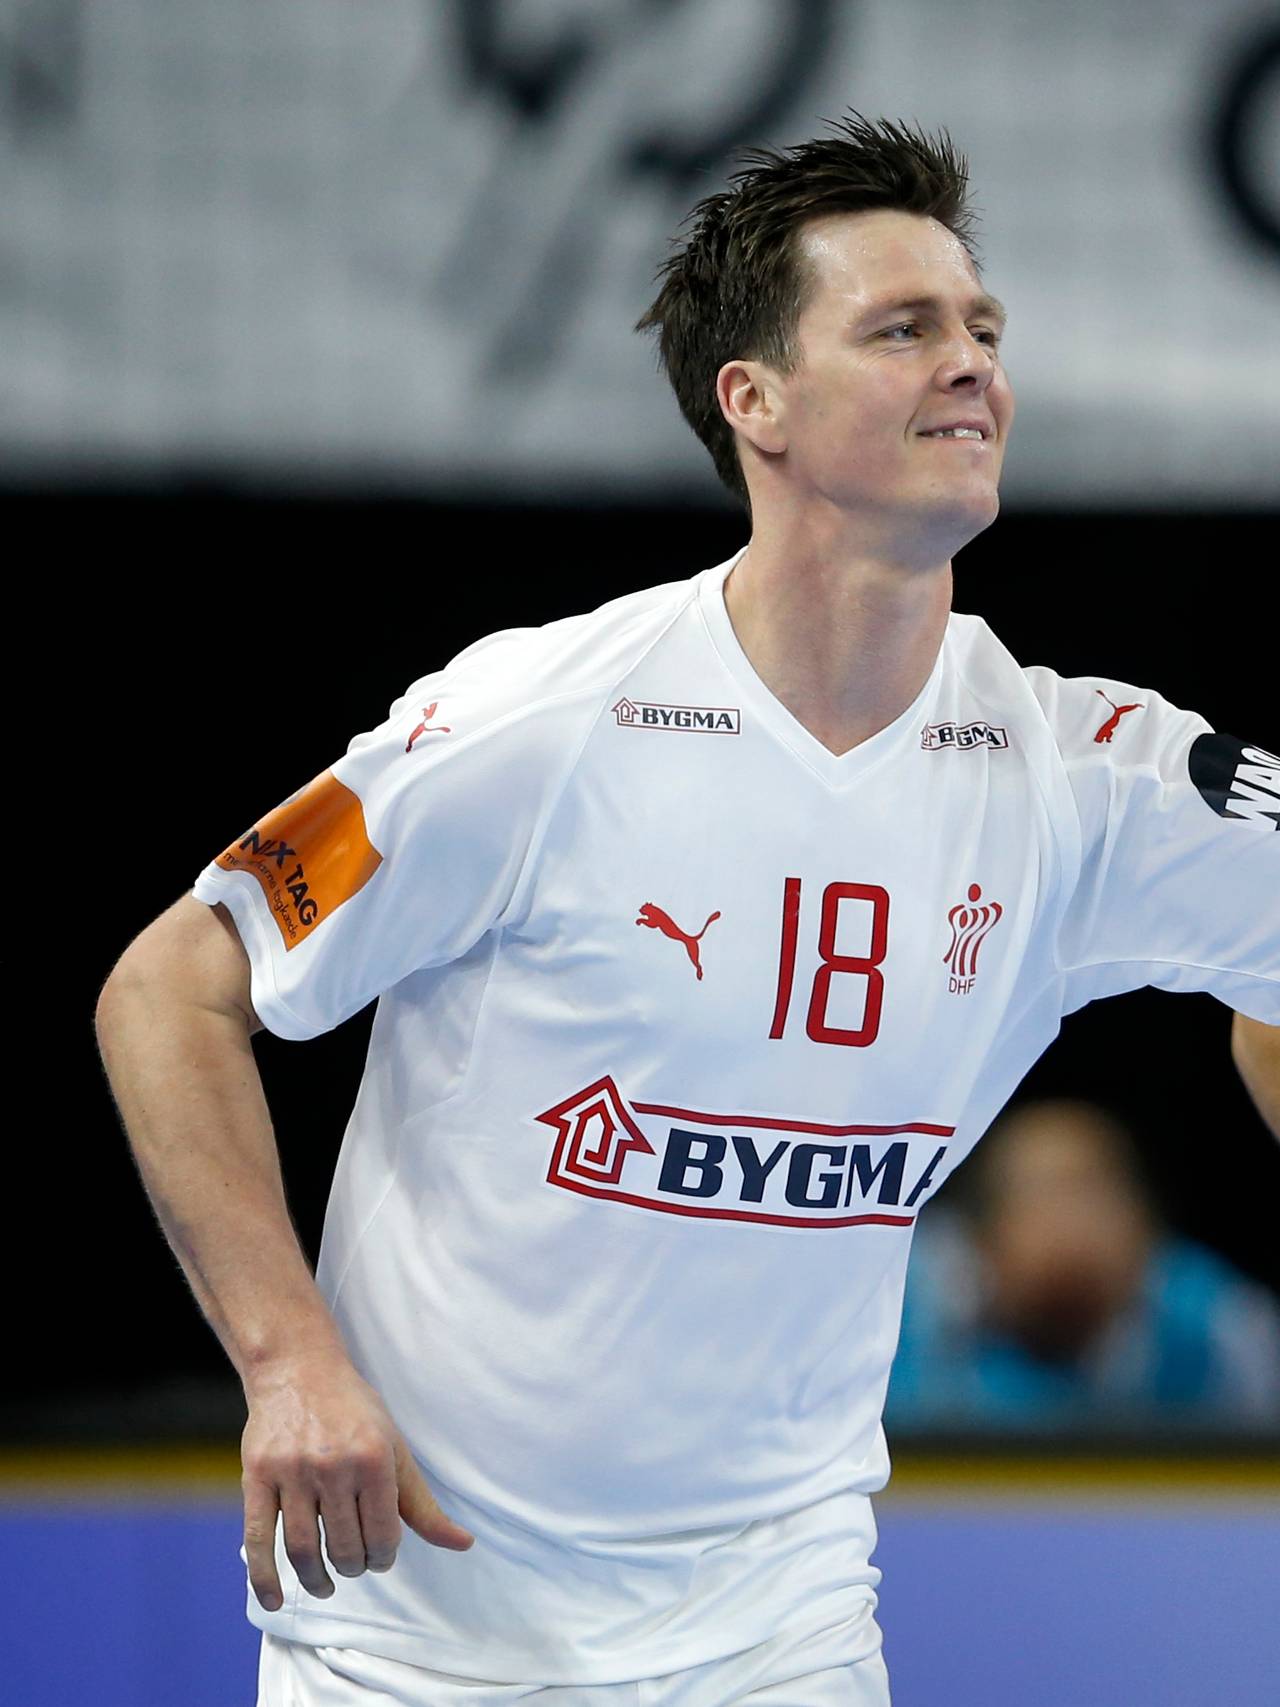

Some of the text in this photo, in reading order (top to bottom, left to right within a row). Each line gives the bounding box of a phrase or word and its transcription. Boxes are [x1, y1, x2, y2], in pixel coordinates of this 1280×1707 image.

[641, 707, 734, 731] BYGMA
[937, 726, 1001, 746] BGMA
[285, 863, 318, 926] TAG
[768, 877, 890, 1048] 18
[948, 977, 976, 996] DHF
